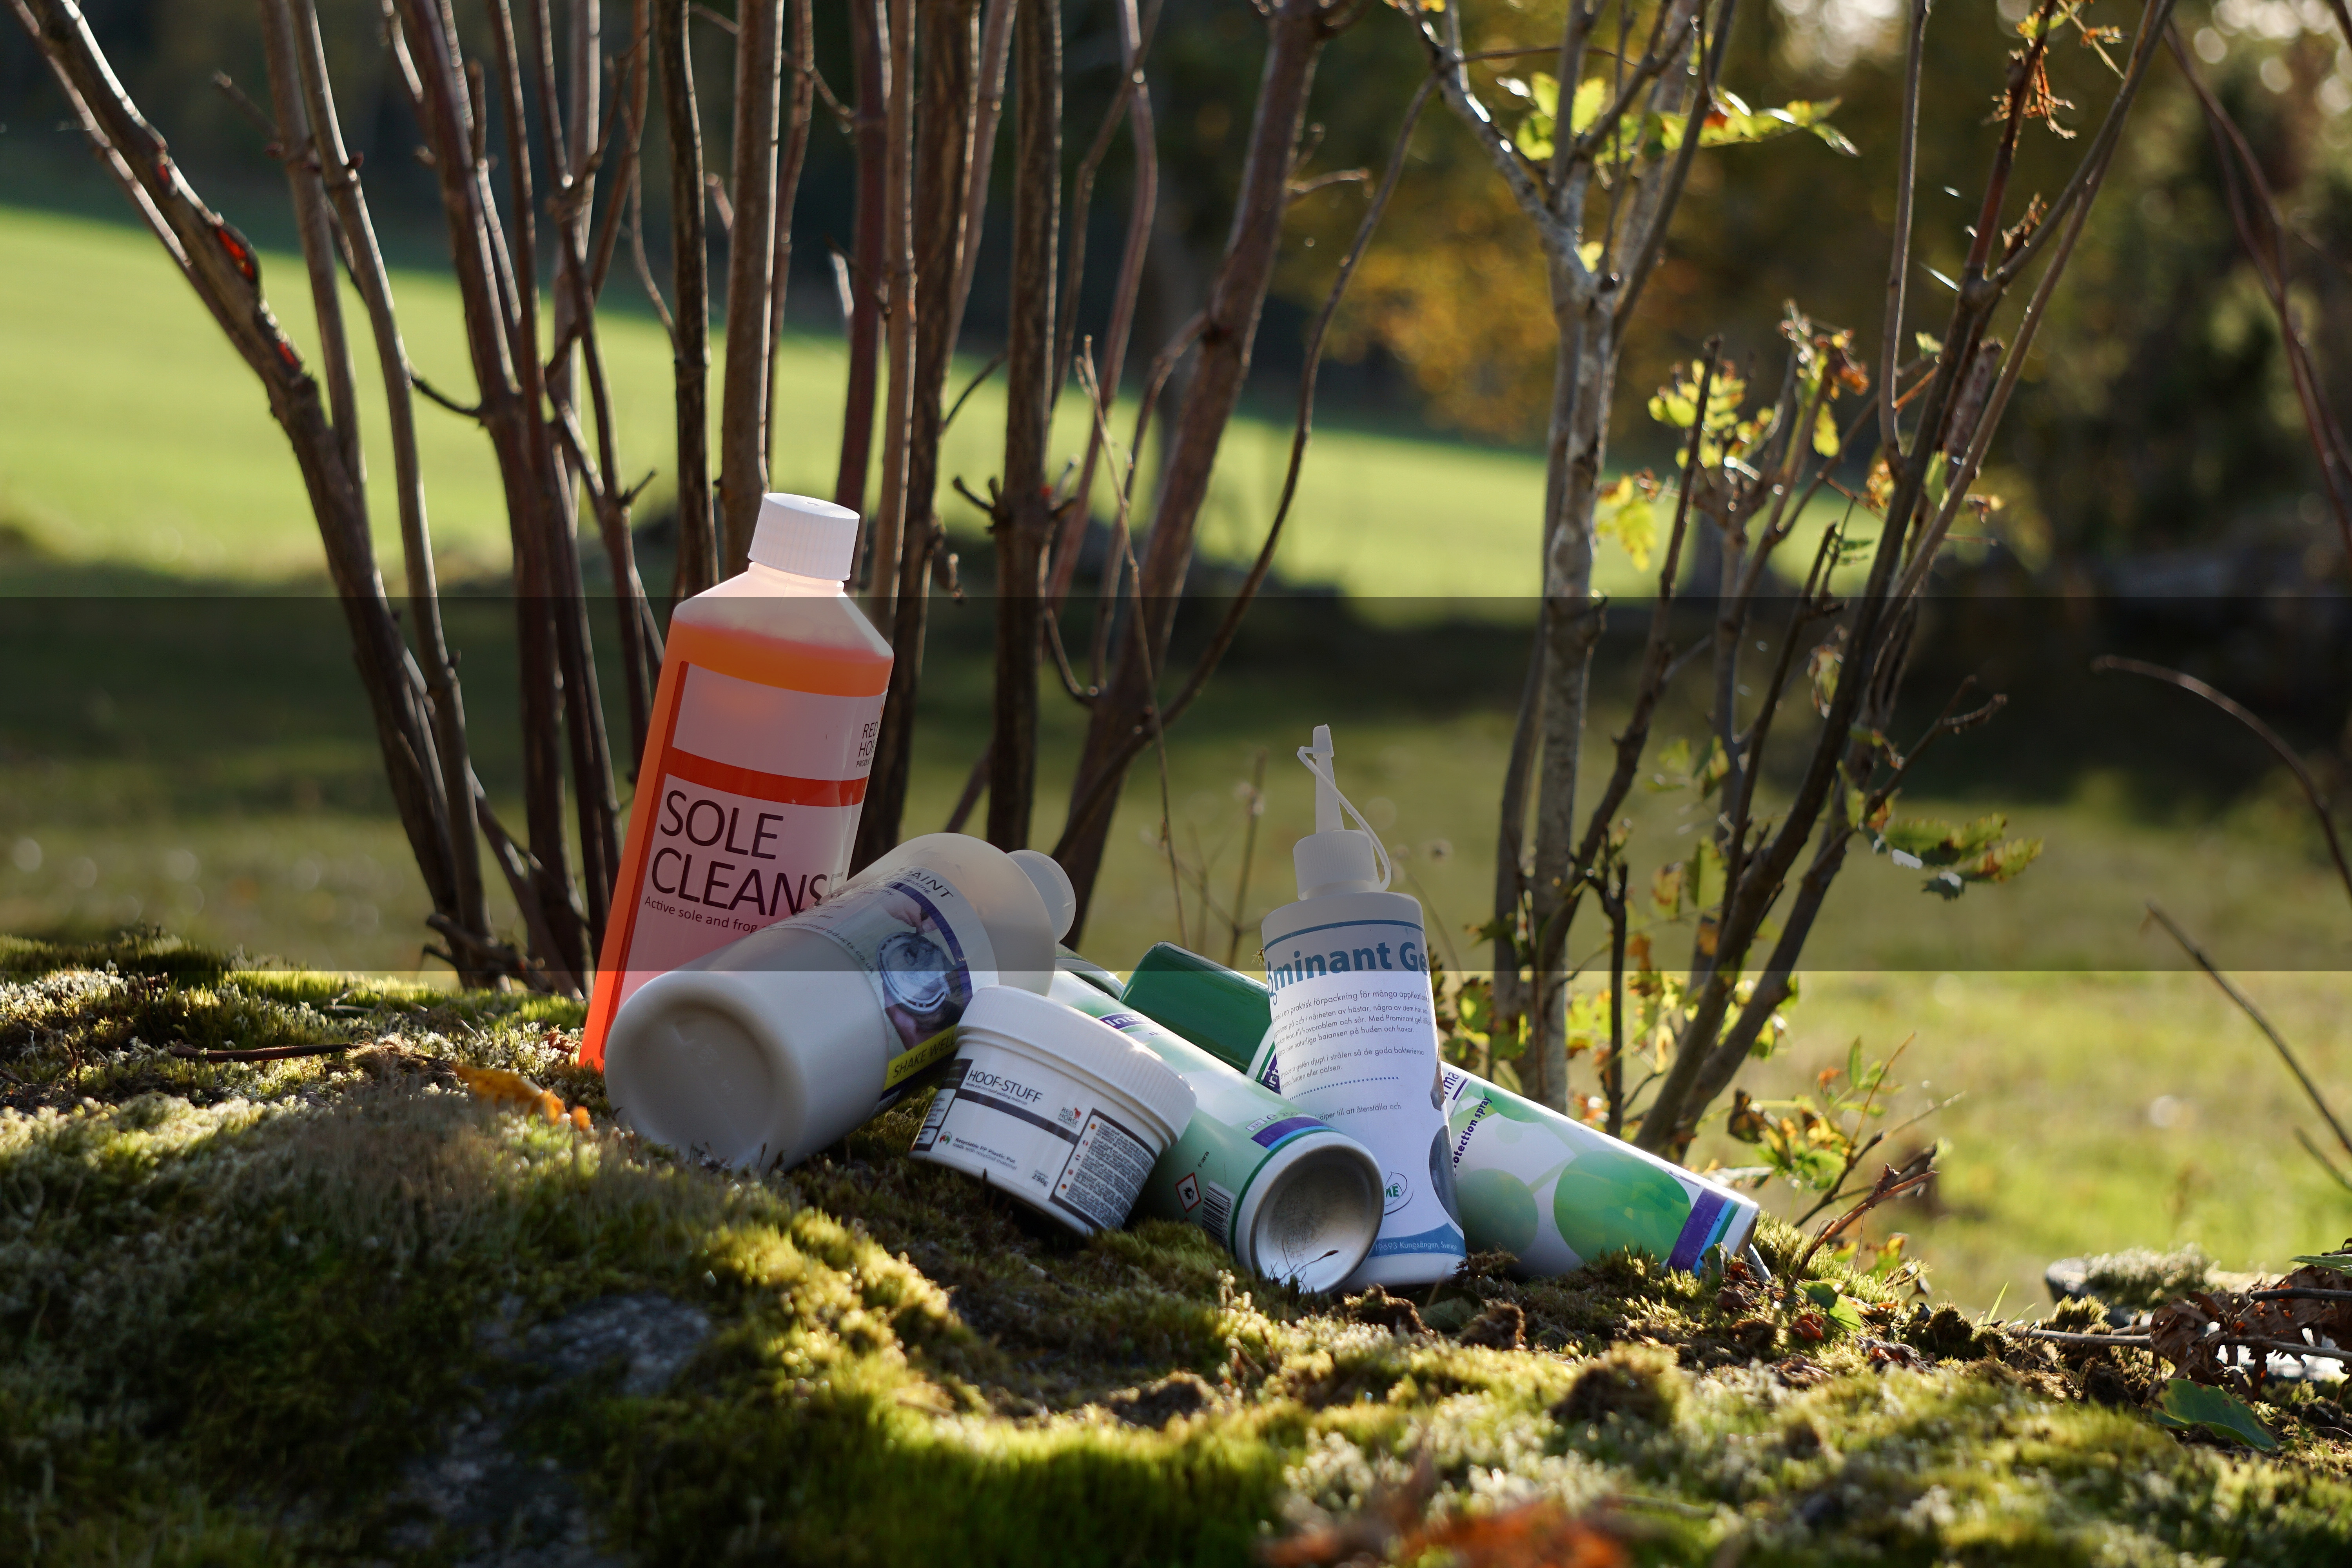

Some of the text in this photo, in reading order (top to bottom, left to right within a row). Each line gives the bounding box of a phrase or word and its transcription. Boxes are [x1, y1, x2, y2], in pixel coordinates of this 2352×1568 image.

[862, 721, 878, 739] RED
[661, 790, 784, 860] SOLE
[644, 896, 759, 933] Active sole and frog
[1291, 999, 1312, 1015] praktisk
[1314, 993, 1357, 1006] förpackning
[1373, 989, 1397, 999] många
[1289, 1020, 1294, 1030] på
[1296, 1016, 1305, 1025] och
[1309, 1011, 1336, 1021] närheten
[1403, 1004, 1414, 1012] dem
[1286, 1032, 1295, 1041] leda
[1302, 1021, 1338, 1033] hovproblem
[1339, 1017, 1352, 1026] och
[1294, 1037, 1317, 1048] naturliga
[1318, 1031, 1348, 1040] balansen
[1350, 1027, 1359, 1036] på
[1397, 1024, 1414, 1033] hovar.
[893, 1033, 955, 1078] SHAKE WELL
[1296, 1061, 1309, 1072] gelén
[1311, 1056, 1325, 1066] djupt
[1330, 1051, 1352, 1060] strålen
[1374, 1046, 1392, 1056] goda
[1394, 1046, 1424, 1055] bakterierna
[1292, 1074, 1305, 1083] huden
[1320, 1065, 1342, 1076] pälsen.
[967, 1070, 1043, 1102] HOOF-STUFF
[1062, 1107, 1073, 1116] RED
[1357, 1103, 1387, 1113] återställa
[1474, 1095, 1493, 1118] spray
[1059, 1112, 1079, 1125] HORSE
[955, 1137, 979, 1149] Recyclable
[988, 1149, 1005, 1159] Plastic
[976, 1151, 996, 1161] recycled
[996, 1159, 1017, 1170] material
[1198, 1151, 1210, 1168] Fara
[1032, 1174, 1049, 1187] 290g
[1399, 1241, 1439, 1250] Kungsängen,
[1441, 1241, 1457, 1251] Sverige
